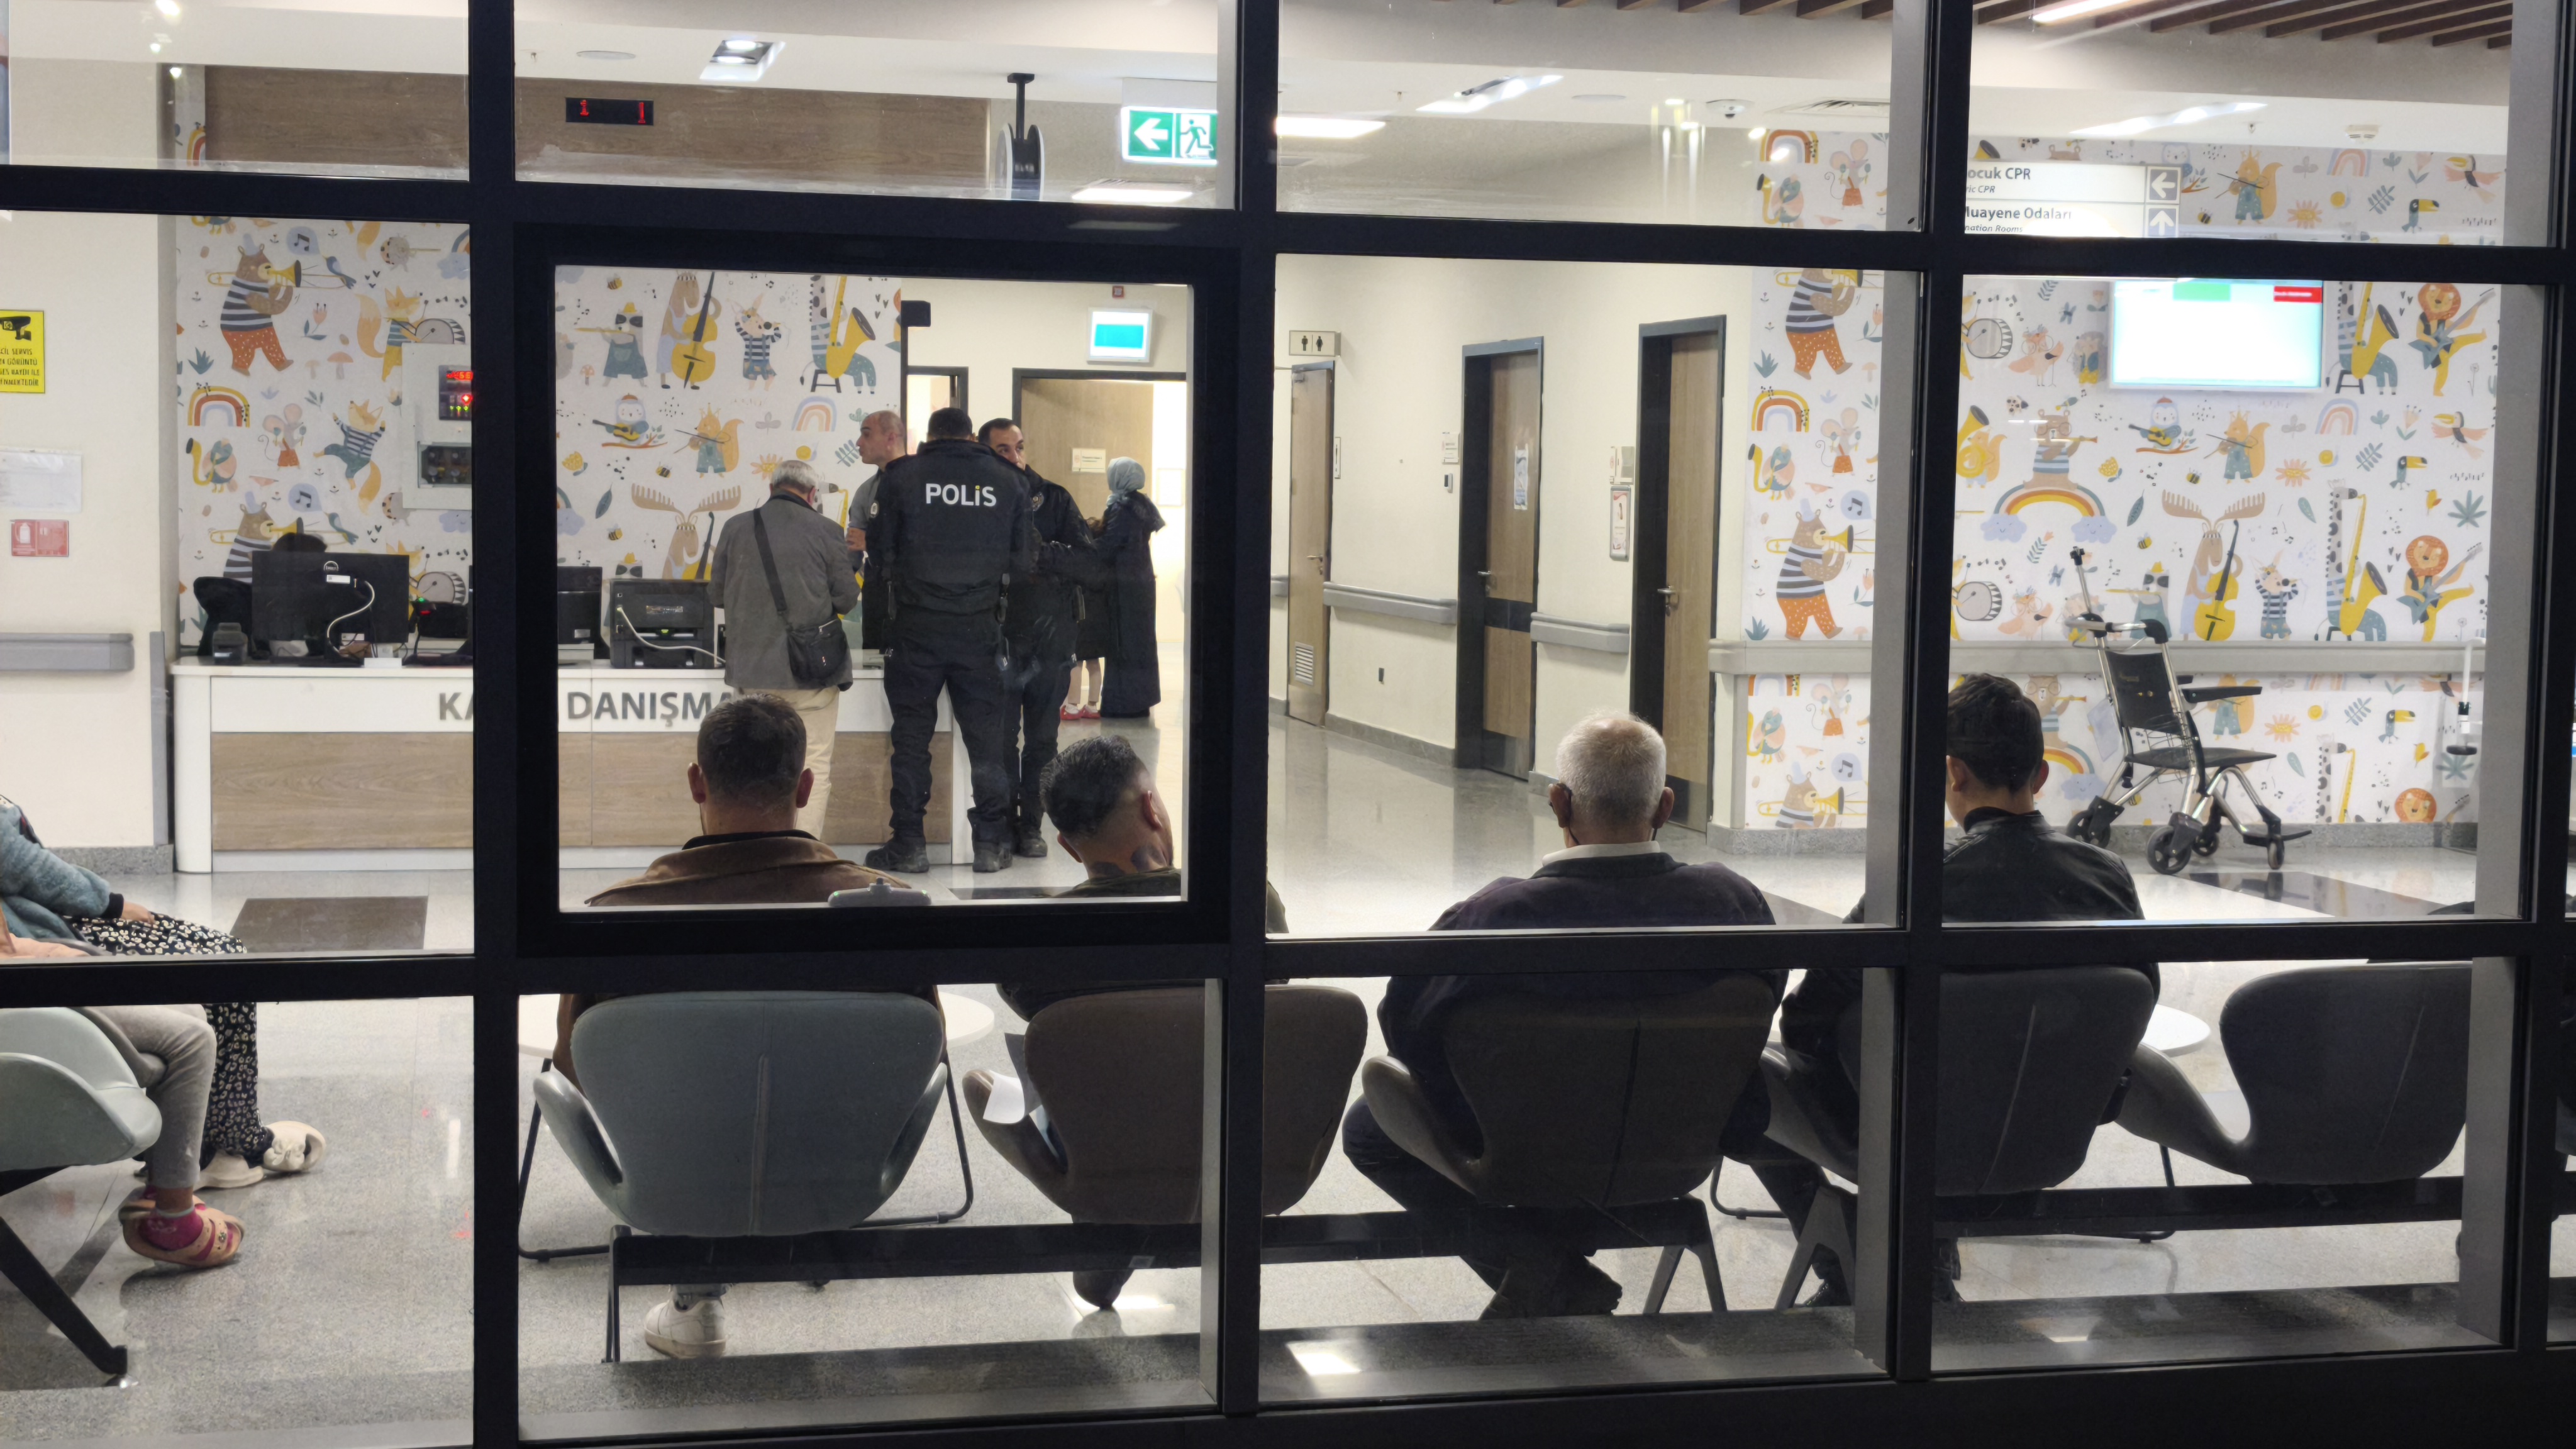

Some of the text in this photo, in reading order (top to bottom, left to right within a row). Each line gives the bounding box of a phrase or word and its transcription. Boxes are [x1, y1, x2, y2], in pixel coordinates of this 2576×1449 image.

[1968, 167, 2031, 180] ocuk CPR
[2024, 207, 2072, 219] Odaları
[568, 692, 731, 727] DANIŞM
